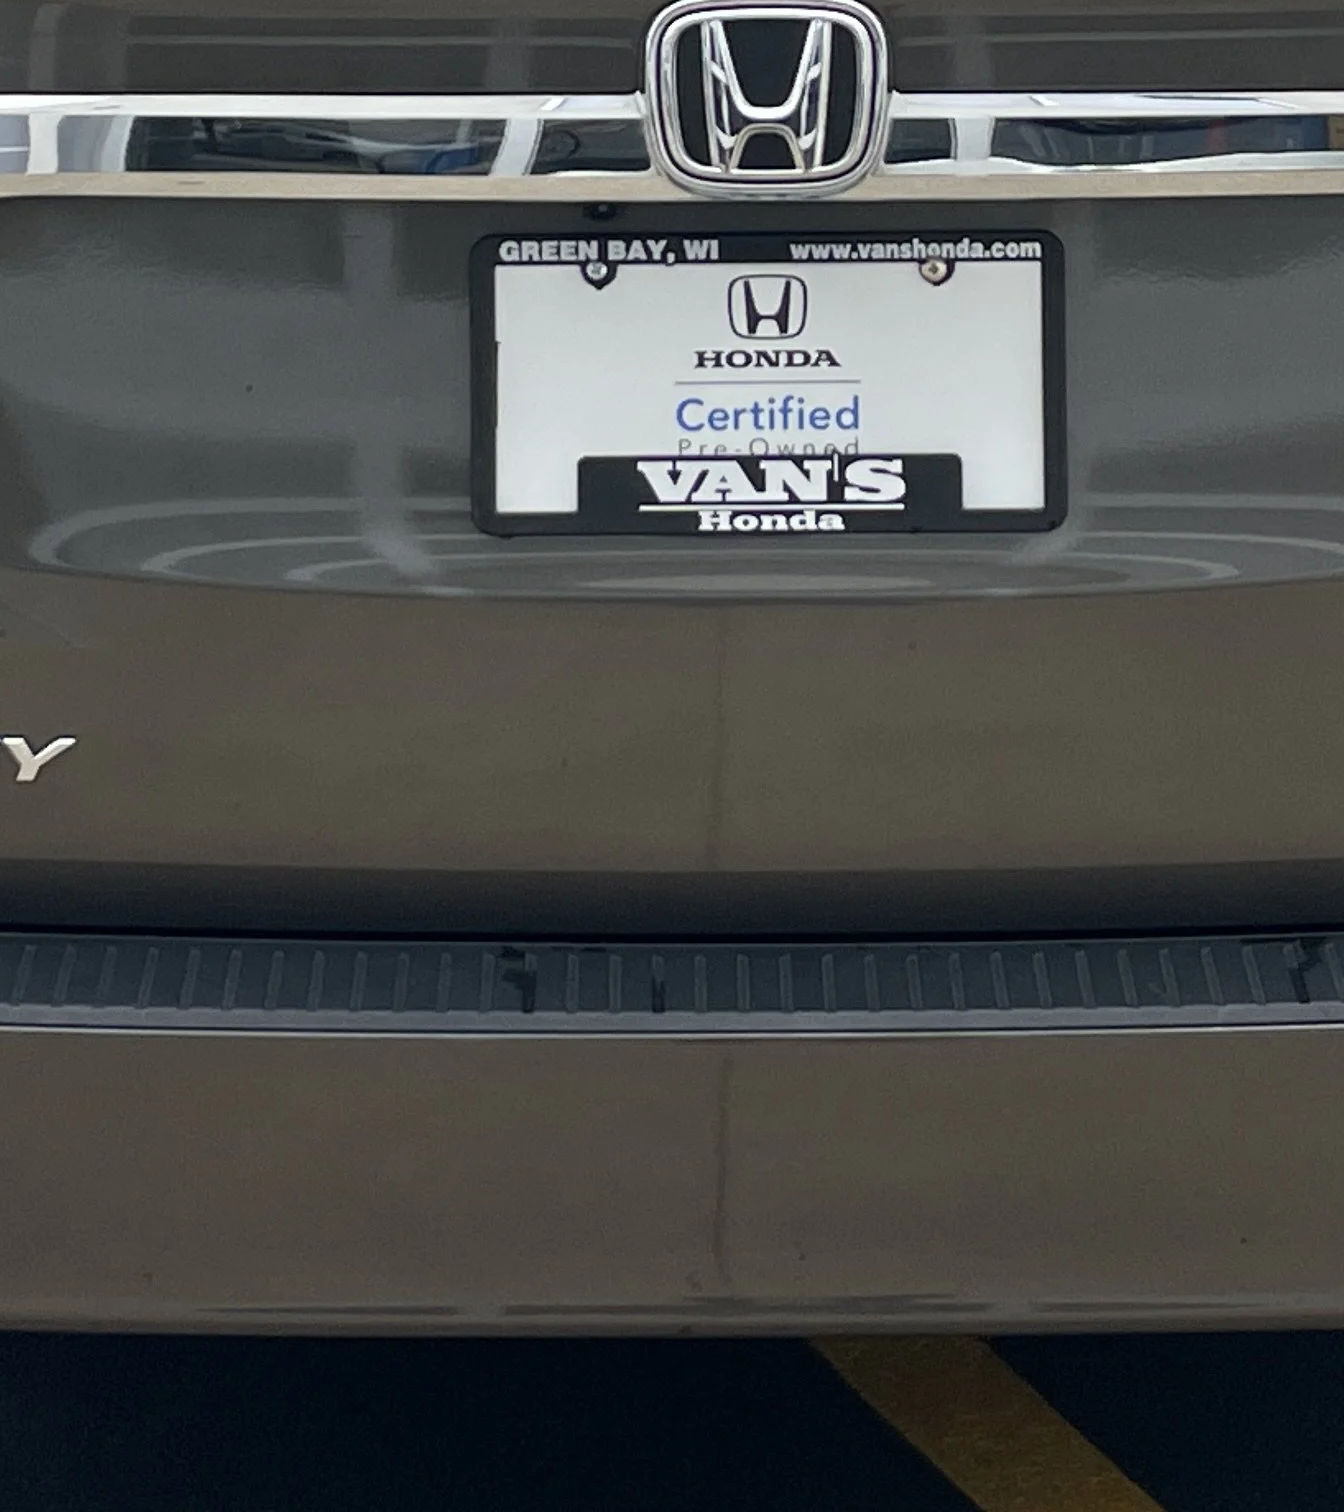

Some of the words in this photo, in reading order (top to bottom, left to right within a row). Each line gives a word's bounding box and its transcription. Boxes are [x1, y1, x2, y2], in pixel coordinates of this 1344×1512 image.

[498, 239, 599, 262] GREEN
[607, 239, 676, 265] BAY,
[683, 239, 720, 261] WI
[789, 238, 1042, 260] www.vanshonda.com
[694, 349, 842, 369] HONDA
[676, 394, 860, 432] Certified
[636, 451, 906, 503] VAN'S
[698, 509, 845, 532] Honda
